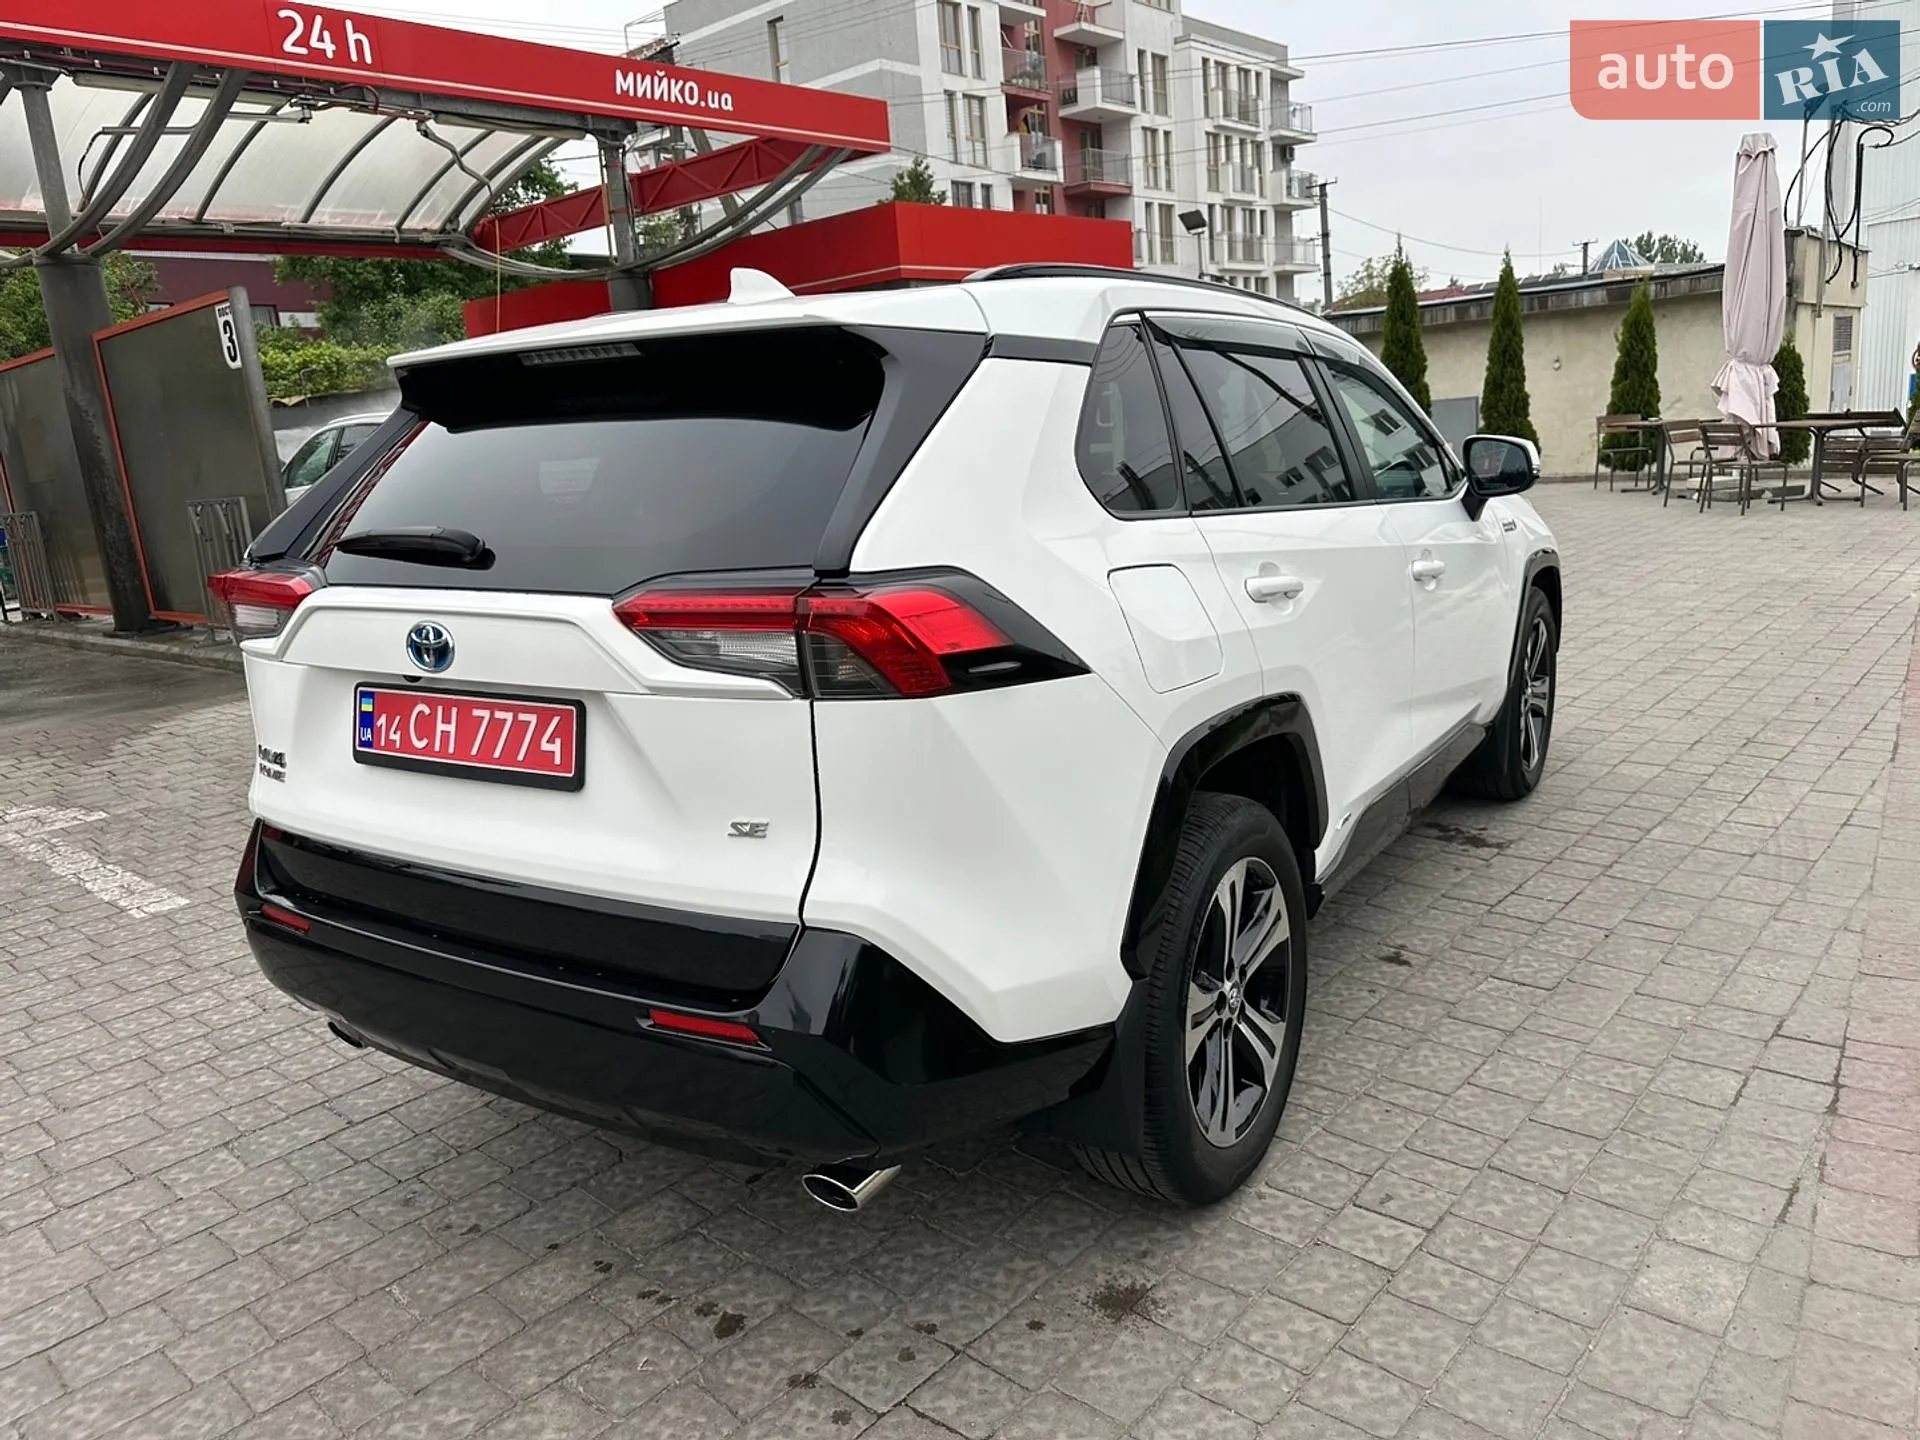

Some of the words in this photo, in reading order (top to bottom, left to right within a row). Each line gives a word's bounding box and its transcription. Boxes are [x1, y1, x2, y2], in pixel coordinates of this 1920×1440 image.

[277, 9, 336, 59] 24
[345, 18, 372, 65] h
[615, 69, 734, 112] МИЙКО.ua
[222, 320, 238, 363] 3
[360, 727, 372, 741] UA
[376, 712, 401, 749] 14
[409, 703, 458, 754] CH
[470, 708, 561, 766] 7774
[728, 822, 769, 839] SE
